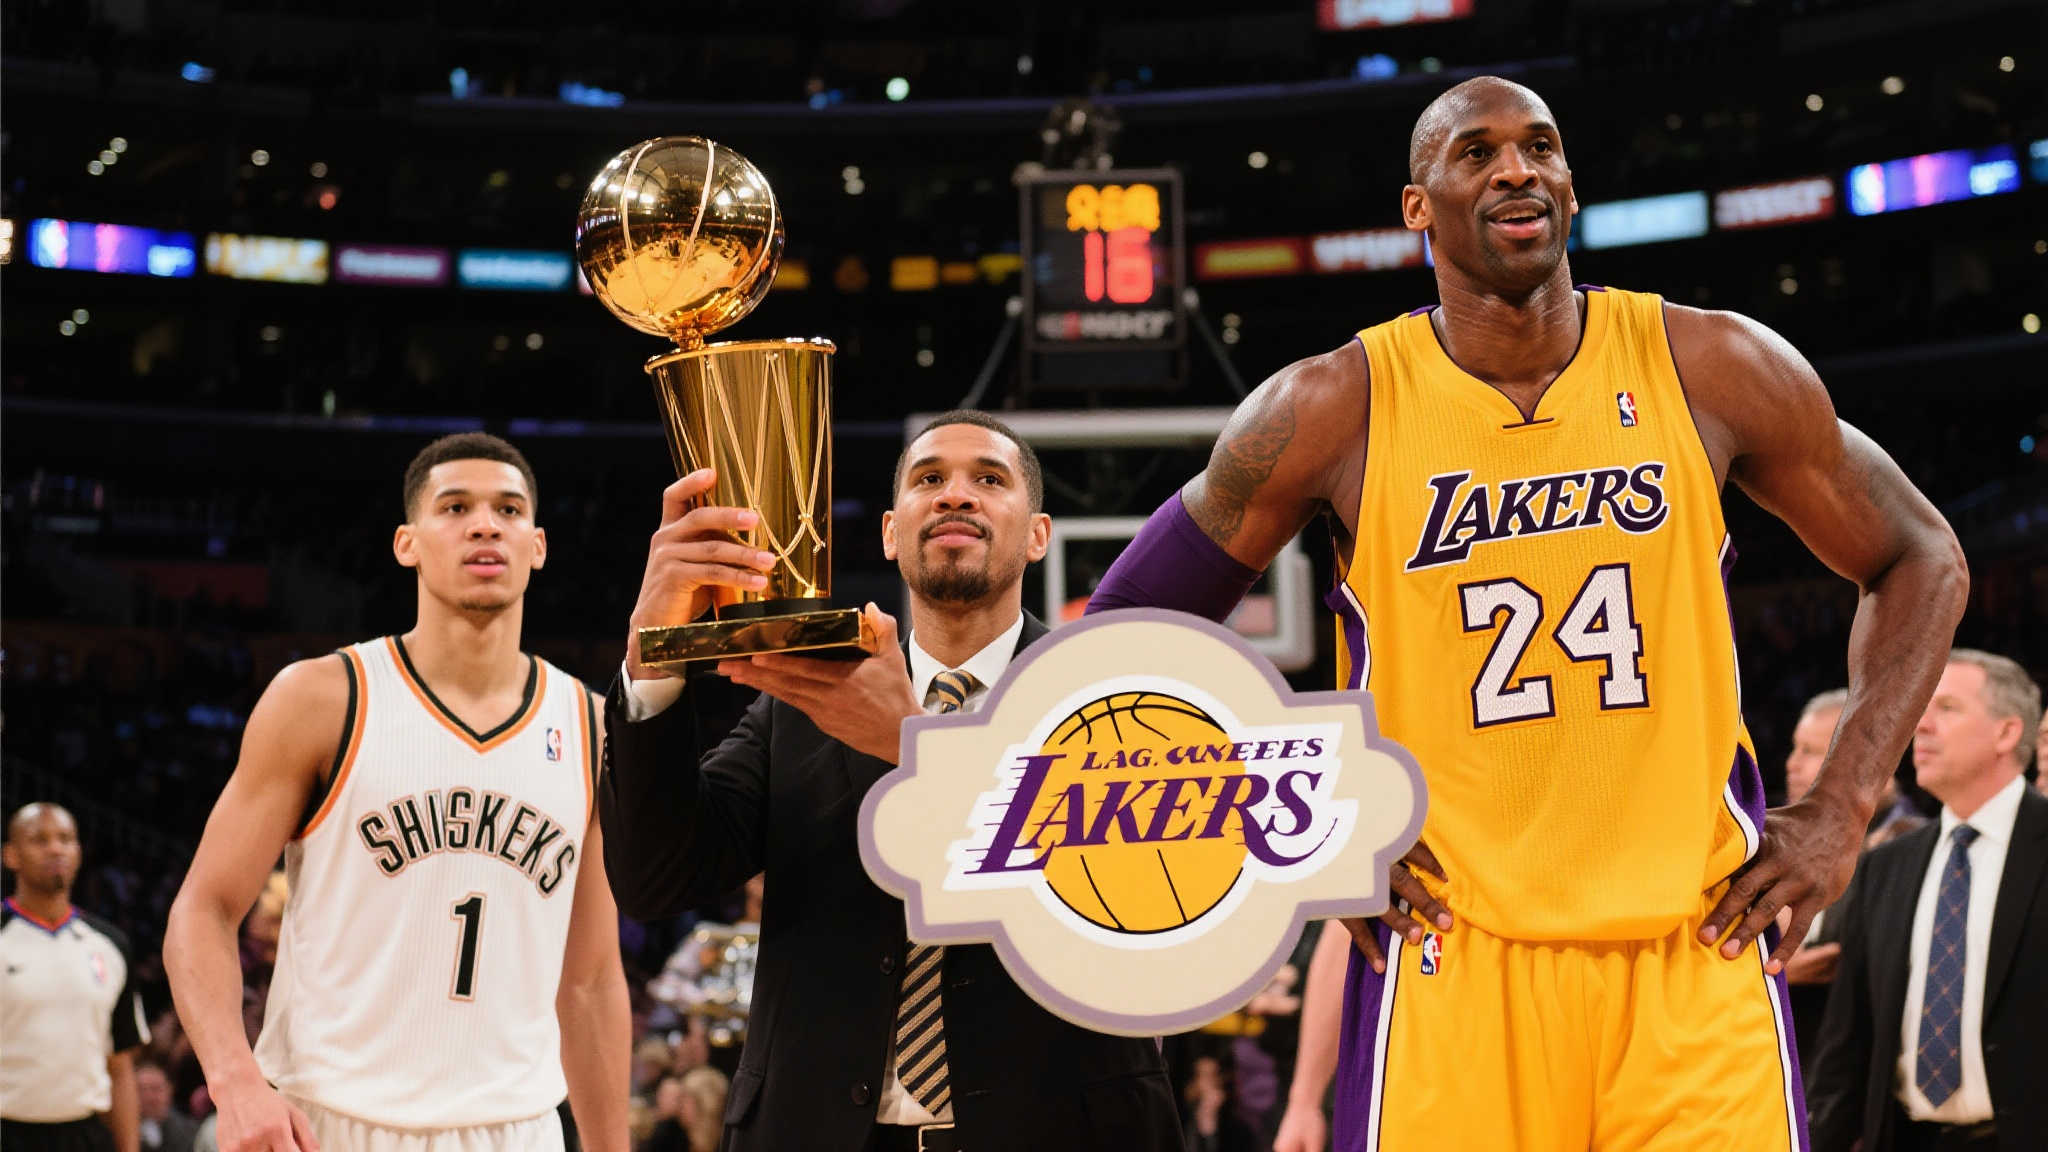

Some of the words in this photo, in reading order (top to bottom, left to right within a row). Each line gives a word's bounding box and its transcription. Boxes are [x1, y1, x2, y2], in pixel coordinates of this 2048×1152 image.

[1404, 461, 1669, 574] LAKERS
[1457, 563, 1650, 729] 24
[1081, 749, 1158, 771] LAG.
[358, 786, 576, 898] SHISKEKS
[963, 770, 1338, 875] LAKERS
[450, 892, 487, 1002] 1
